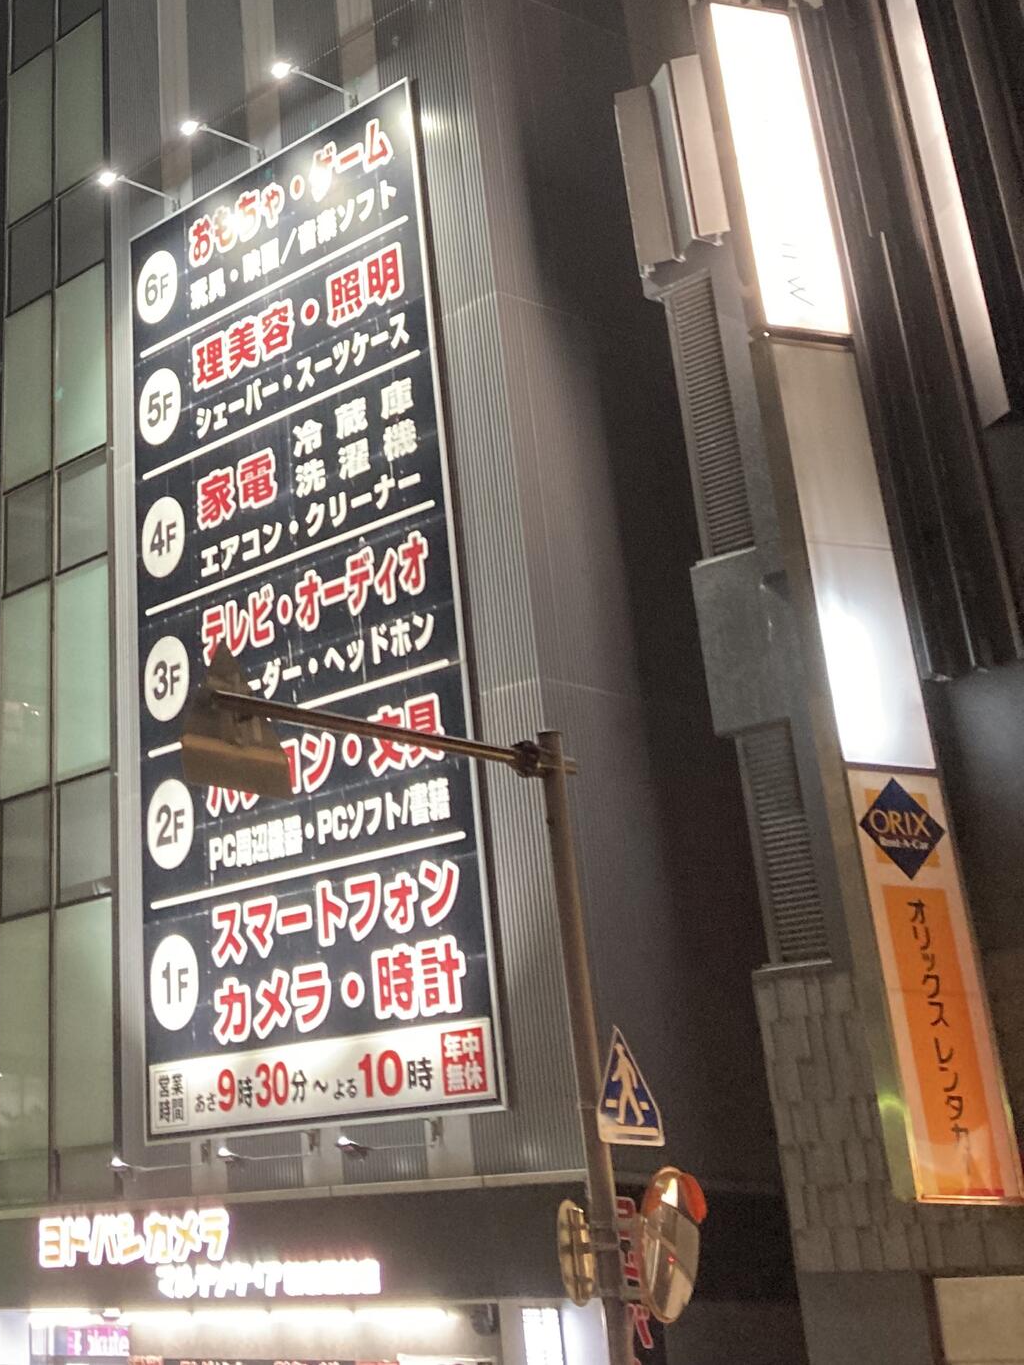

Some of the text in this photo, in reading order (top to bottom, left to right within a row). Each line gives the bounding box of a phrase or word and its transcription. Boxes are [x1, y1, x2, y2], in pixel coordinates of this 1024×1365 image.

[143, 272, 171, 306] 6F
[193, 242, 405, 392] 理美容・照明
[145, 390, 174, 425] 5F
[196, 312, 410, 440] シェーバー・スーツケース
[292, 378, 414, 459] 冷蔵庫
[197, 446, 277, 530] 家電
[294, 420, 419, 499] 洗濯機
[148, 523, 178, 558] 4F
[200, 470, 423, 578] エアコン・クリーナー
[202, 530, 429, 667] テレビ・オーディオ
[153, 660, 182, 697] 3F
[248, 613, 436, 700] ーダー・ヘッドホン
[156, 809, 186, 846] 2F
[868, 806, 932, 839] ORIX
[212, 858, 461, 969] スマートフォン
[159, 960, 190, 1004] 1F
[213, 935, 467, 1045] カメラ・時計
[905, 899, 951, 1027] オリックス
[441, 1031, 483, 1064] 年中
[443, 1062, 486, 1095] 無休
[38, 1207, 230, 1268] ヨドバシカメラ
